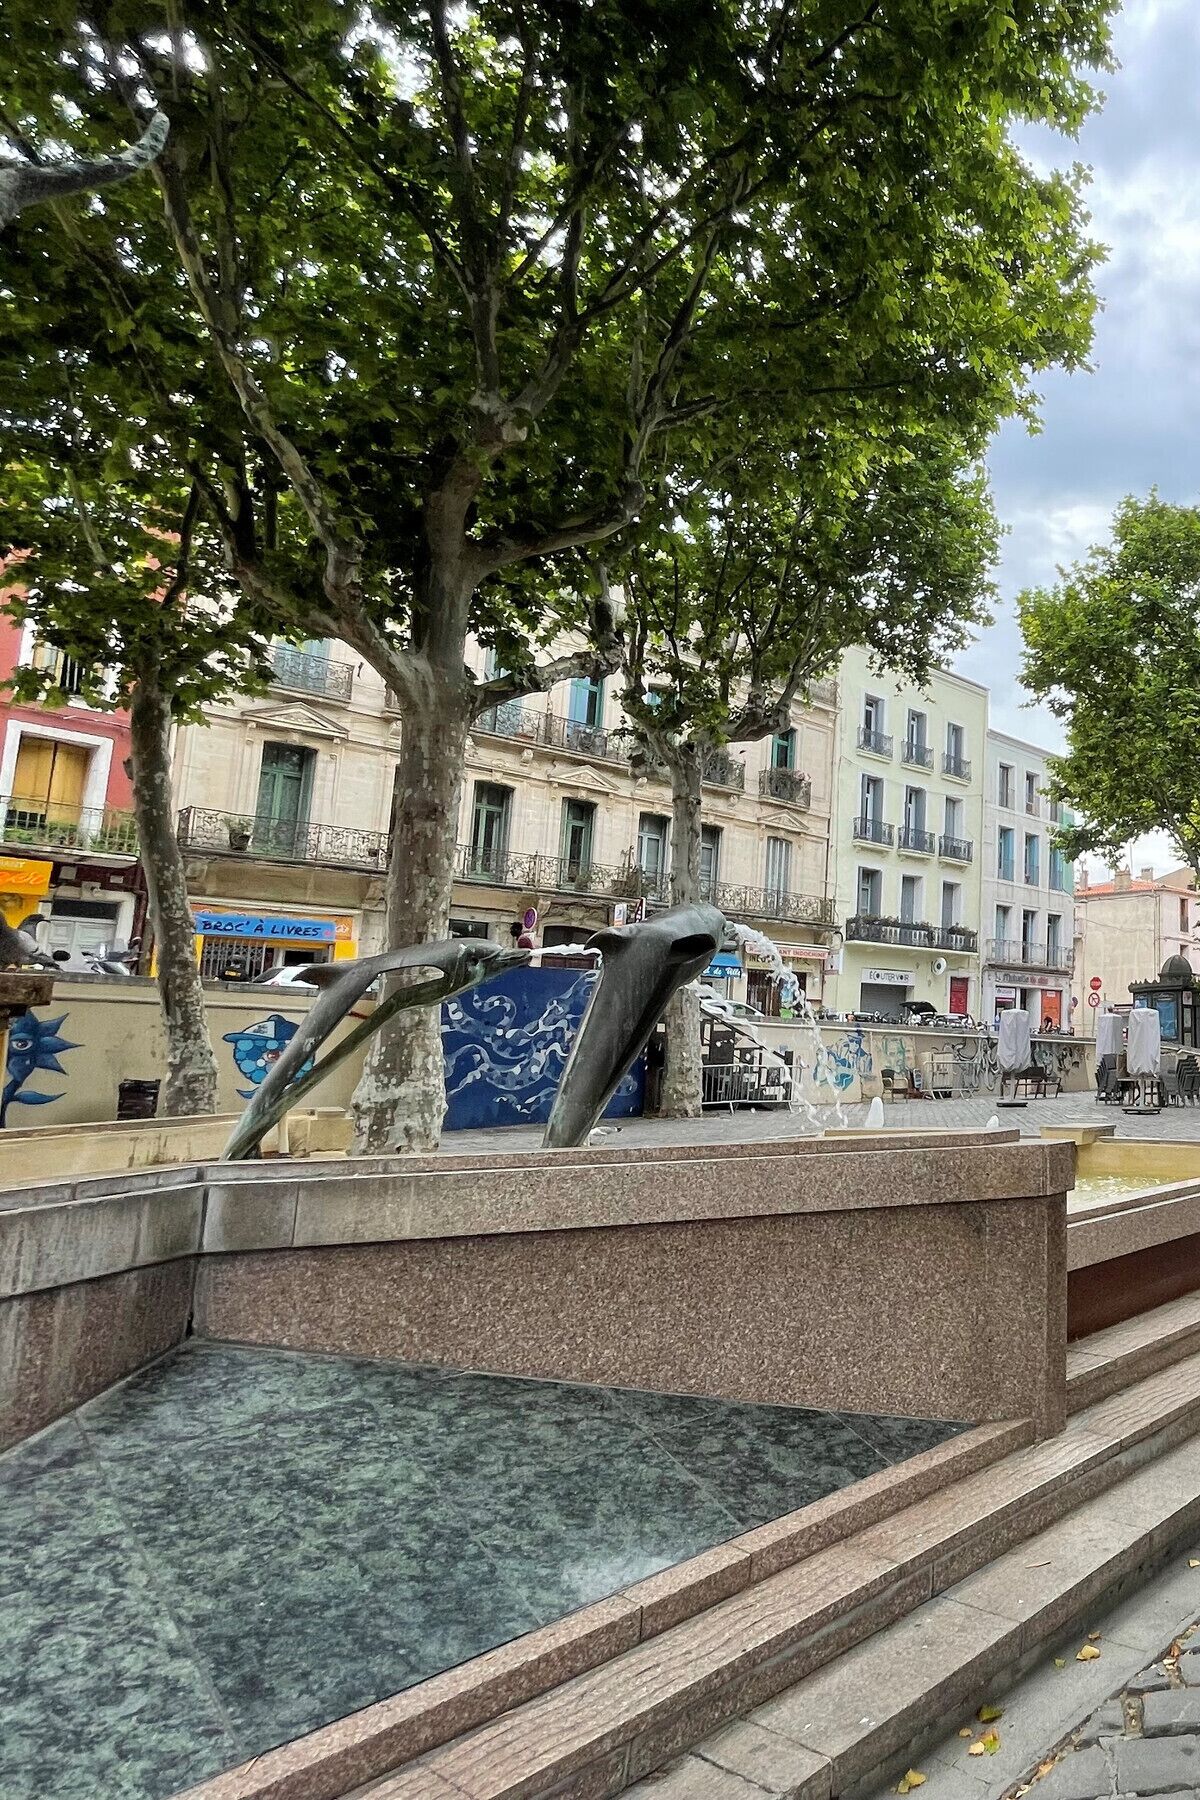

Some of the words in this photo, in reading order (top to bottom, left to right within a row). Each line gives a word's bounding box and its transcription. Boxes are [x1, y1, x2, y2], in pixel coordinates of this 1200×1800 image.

[202, 920, 250, 931] BROC'
[254, 919, 264, 933] À
[271, 924, 321, 936] LIVRES
[793, 950, 826, 958] INDOCHINE
